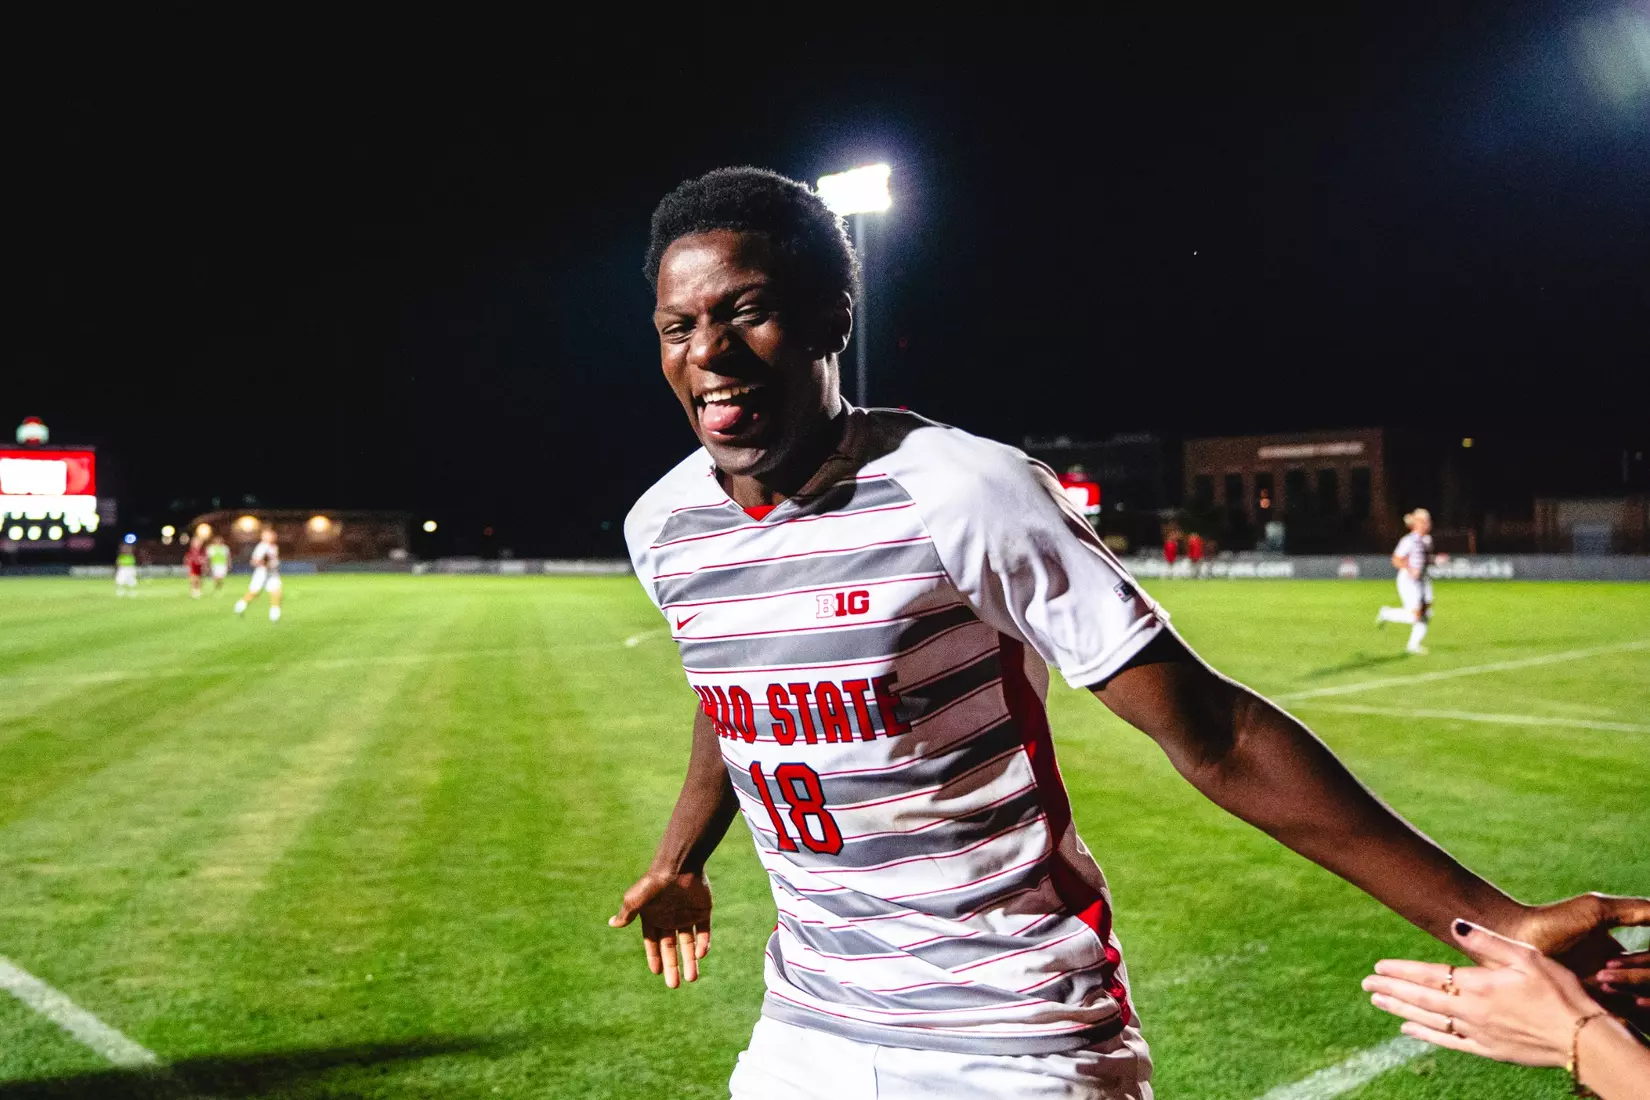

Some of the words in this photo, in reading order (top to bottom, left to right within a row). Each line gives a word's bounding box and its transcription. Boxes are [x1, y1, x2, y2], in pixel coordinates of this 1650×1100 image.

[693, 684, 758, 744] HIO
[766, 671, 912, 746] STATE
[749, 760, 845, 856] 18
